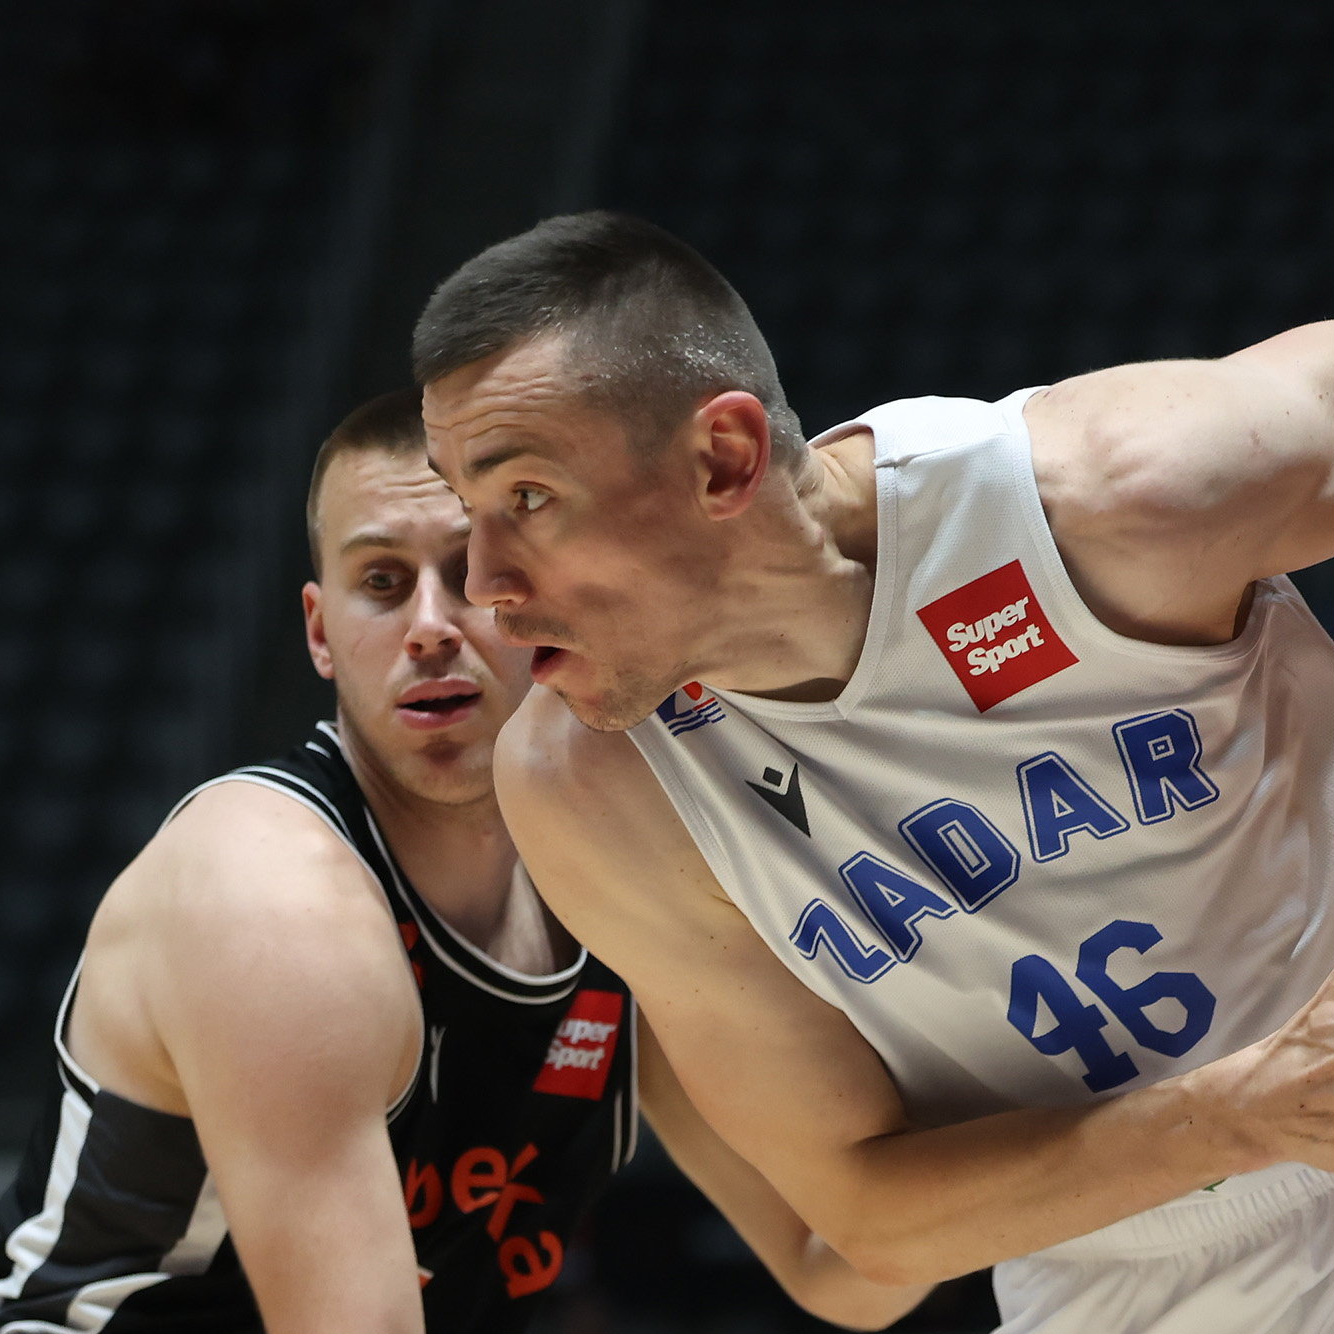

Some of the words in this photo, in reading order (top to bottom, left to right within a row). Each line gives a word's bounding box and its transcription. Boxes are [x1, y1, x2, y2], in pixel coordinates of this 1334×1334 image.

[947, 596, 1029, 652] Super
[967, 624, 1045, 676] Sport
[789, 708, 1220, 985] ZADAR
[557, 1019, 617, 1044] uper
[1007, 919, 1216, 1093] 46
